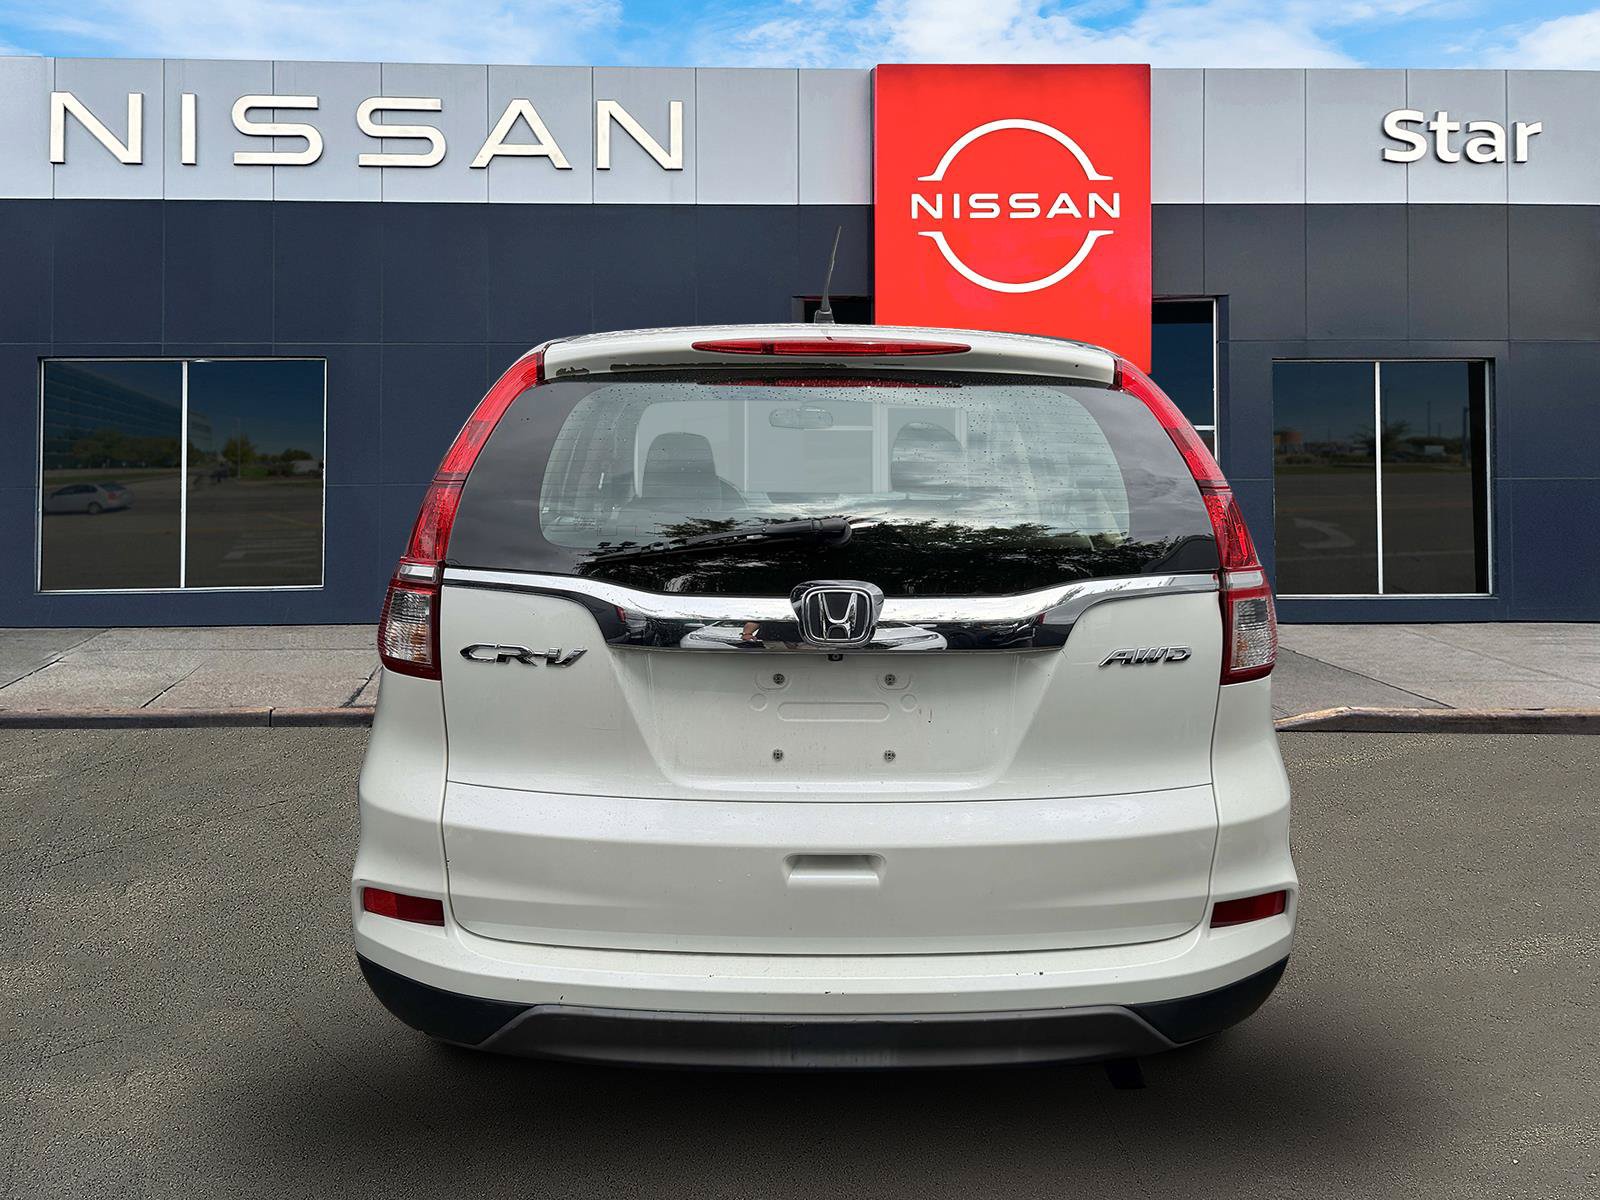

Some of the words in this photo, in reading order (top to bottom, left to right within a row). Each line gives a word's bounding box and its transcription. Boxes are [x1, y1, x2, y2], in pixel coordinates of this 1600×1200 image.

[50, 91, 683, 170] NISSAN
[1381, 108, 1542, 163] Star
[911, 192, 1121, 219] NISSAN
[460, 643, 588, 667] CR-V
[1099, 645, 1193, 668] AWD
